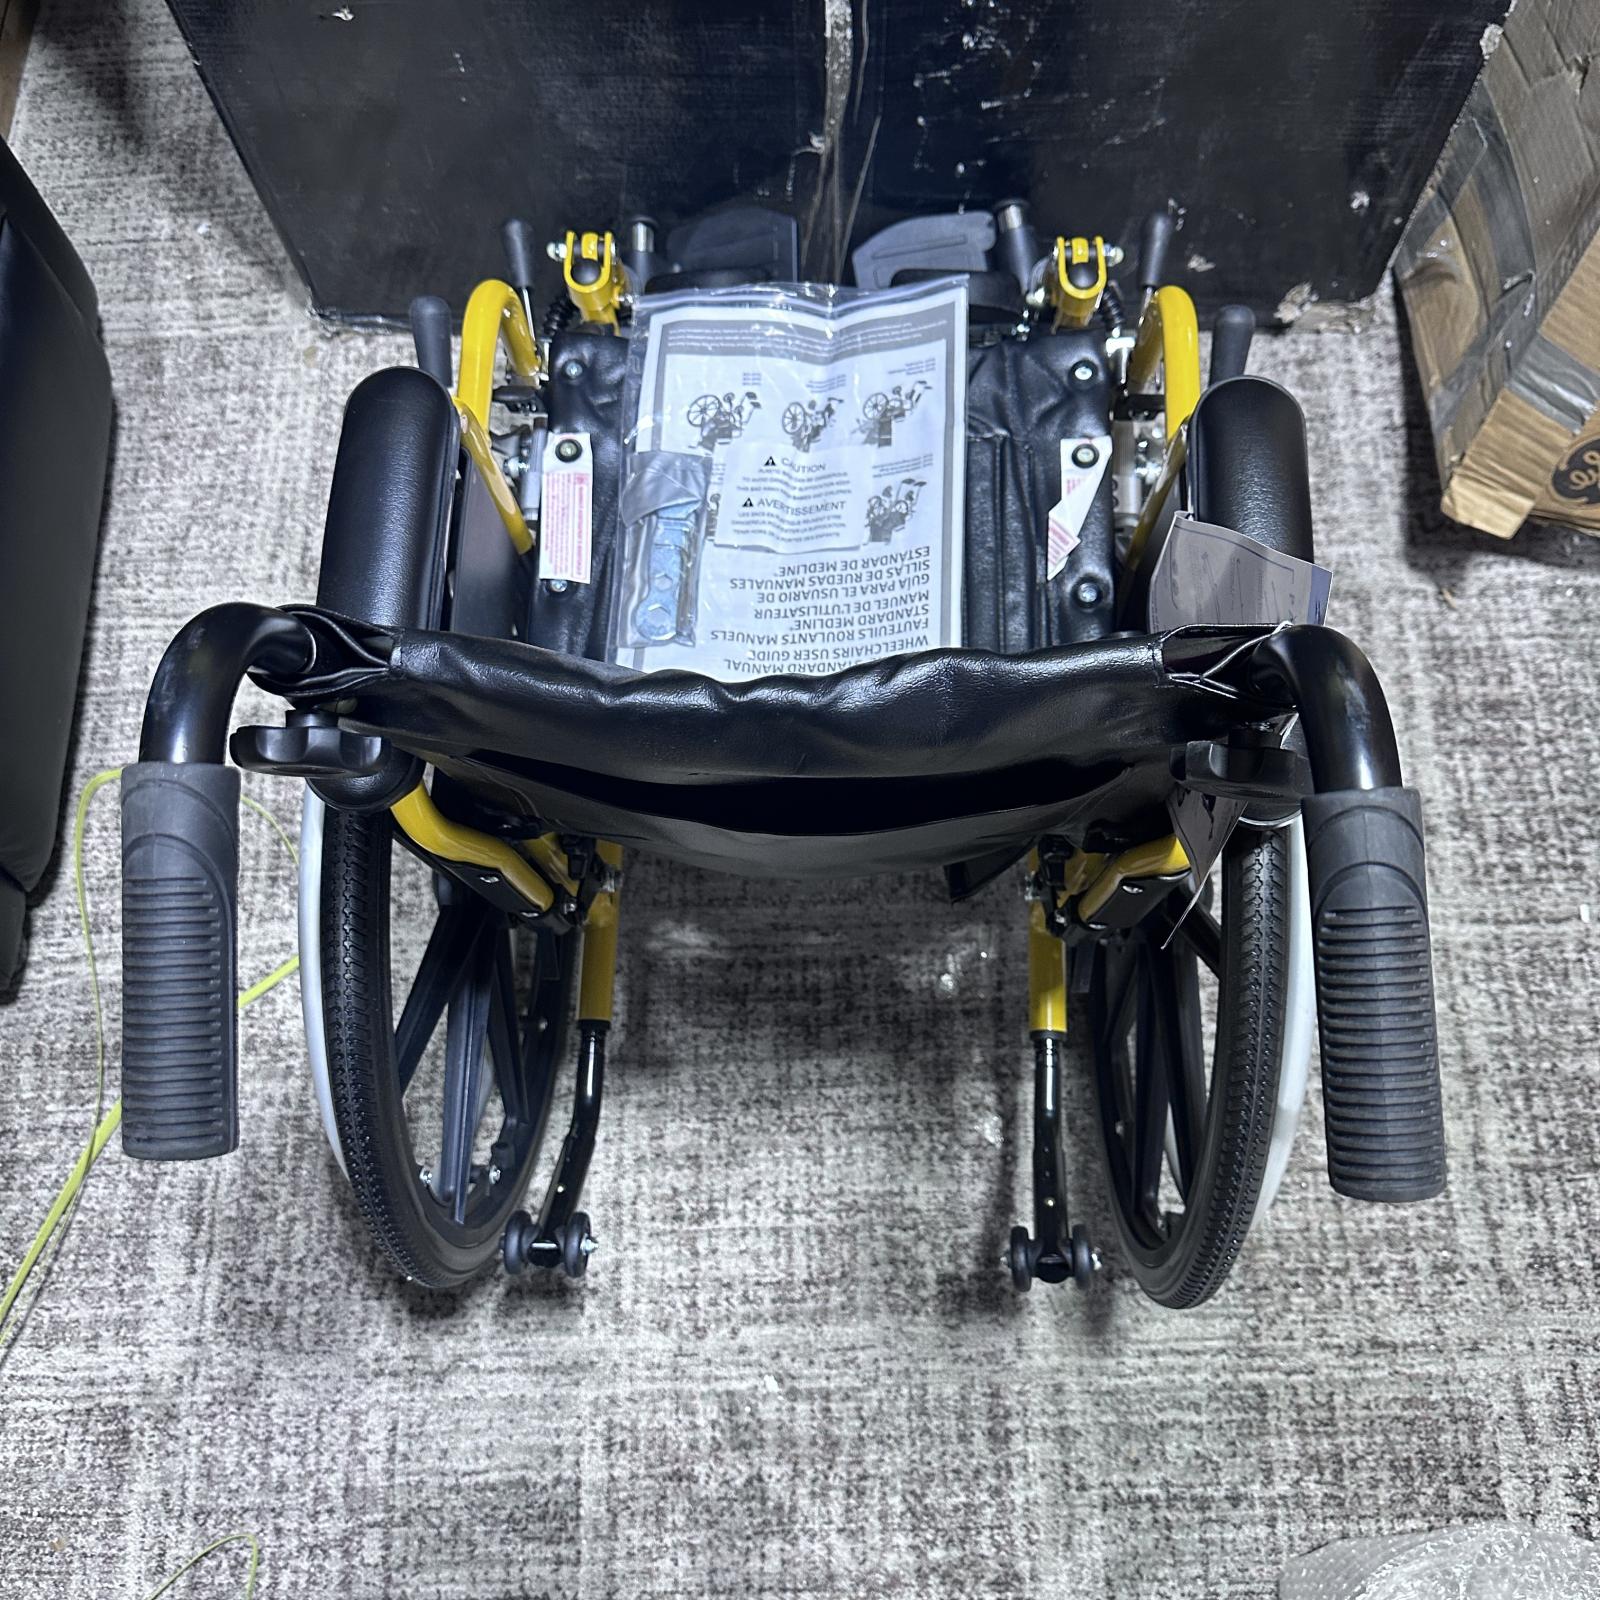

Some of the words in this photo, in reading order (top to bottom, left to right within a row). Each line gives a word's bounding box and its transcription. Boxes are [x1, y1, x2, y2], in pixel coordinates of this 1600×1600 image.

[780, 457, 826, 473] CAUTION
[757, 498, 846, 516] AVERTISSEMENT
[841, 560, 858, 570] DE
[887, 560, 930, 577] SILLAS
[808, 573, 863, 587] RUEDAS
[867, 570, 883, 581] DE
[899, 573, 930, 590] GUÍA
[730, 578, 805, 589] MANUALES
[861, 582, 895, 595] PARA
[757, 592, 775, 603] DE
[778, 588, 839, 602] USUARIO
[842, 587, 857, 597] EL
[874, 590, 929, 610] MANUEL
[754, 603, 850, 619] L'UTILISATEUR
[854, 602, 871, 613] DE
[858, 604, 929, 626] STANDARD
[858, 618, 929, 639] FAUTEUILS
[710, 630, 778, 646] MANUELS
[782, 631, 855, 645] ROULANTS
[833, 634, 929, 659] WHEELCHAIRS
[793, 649, 829, 662] USER
[724, 658, 784, 674] MANUAL
[787, 661, 860, 674] ANDARD
